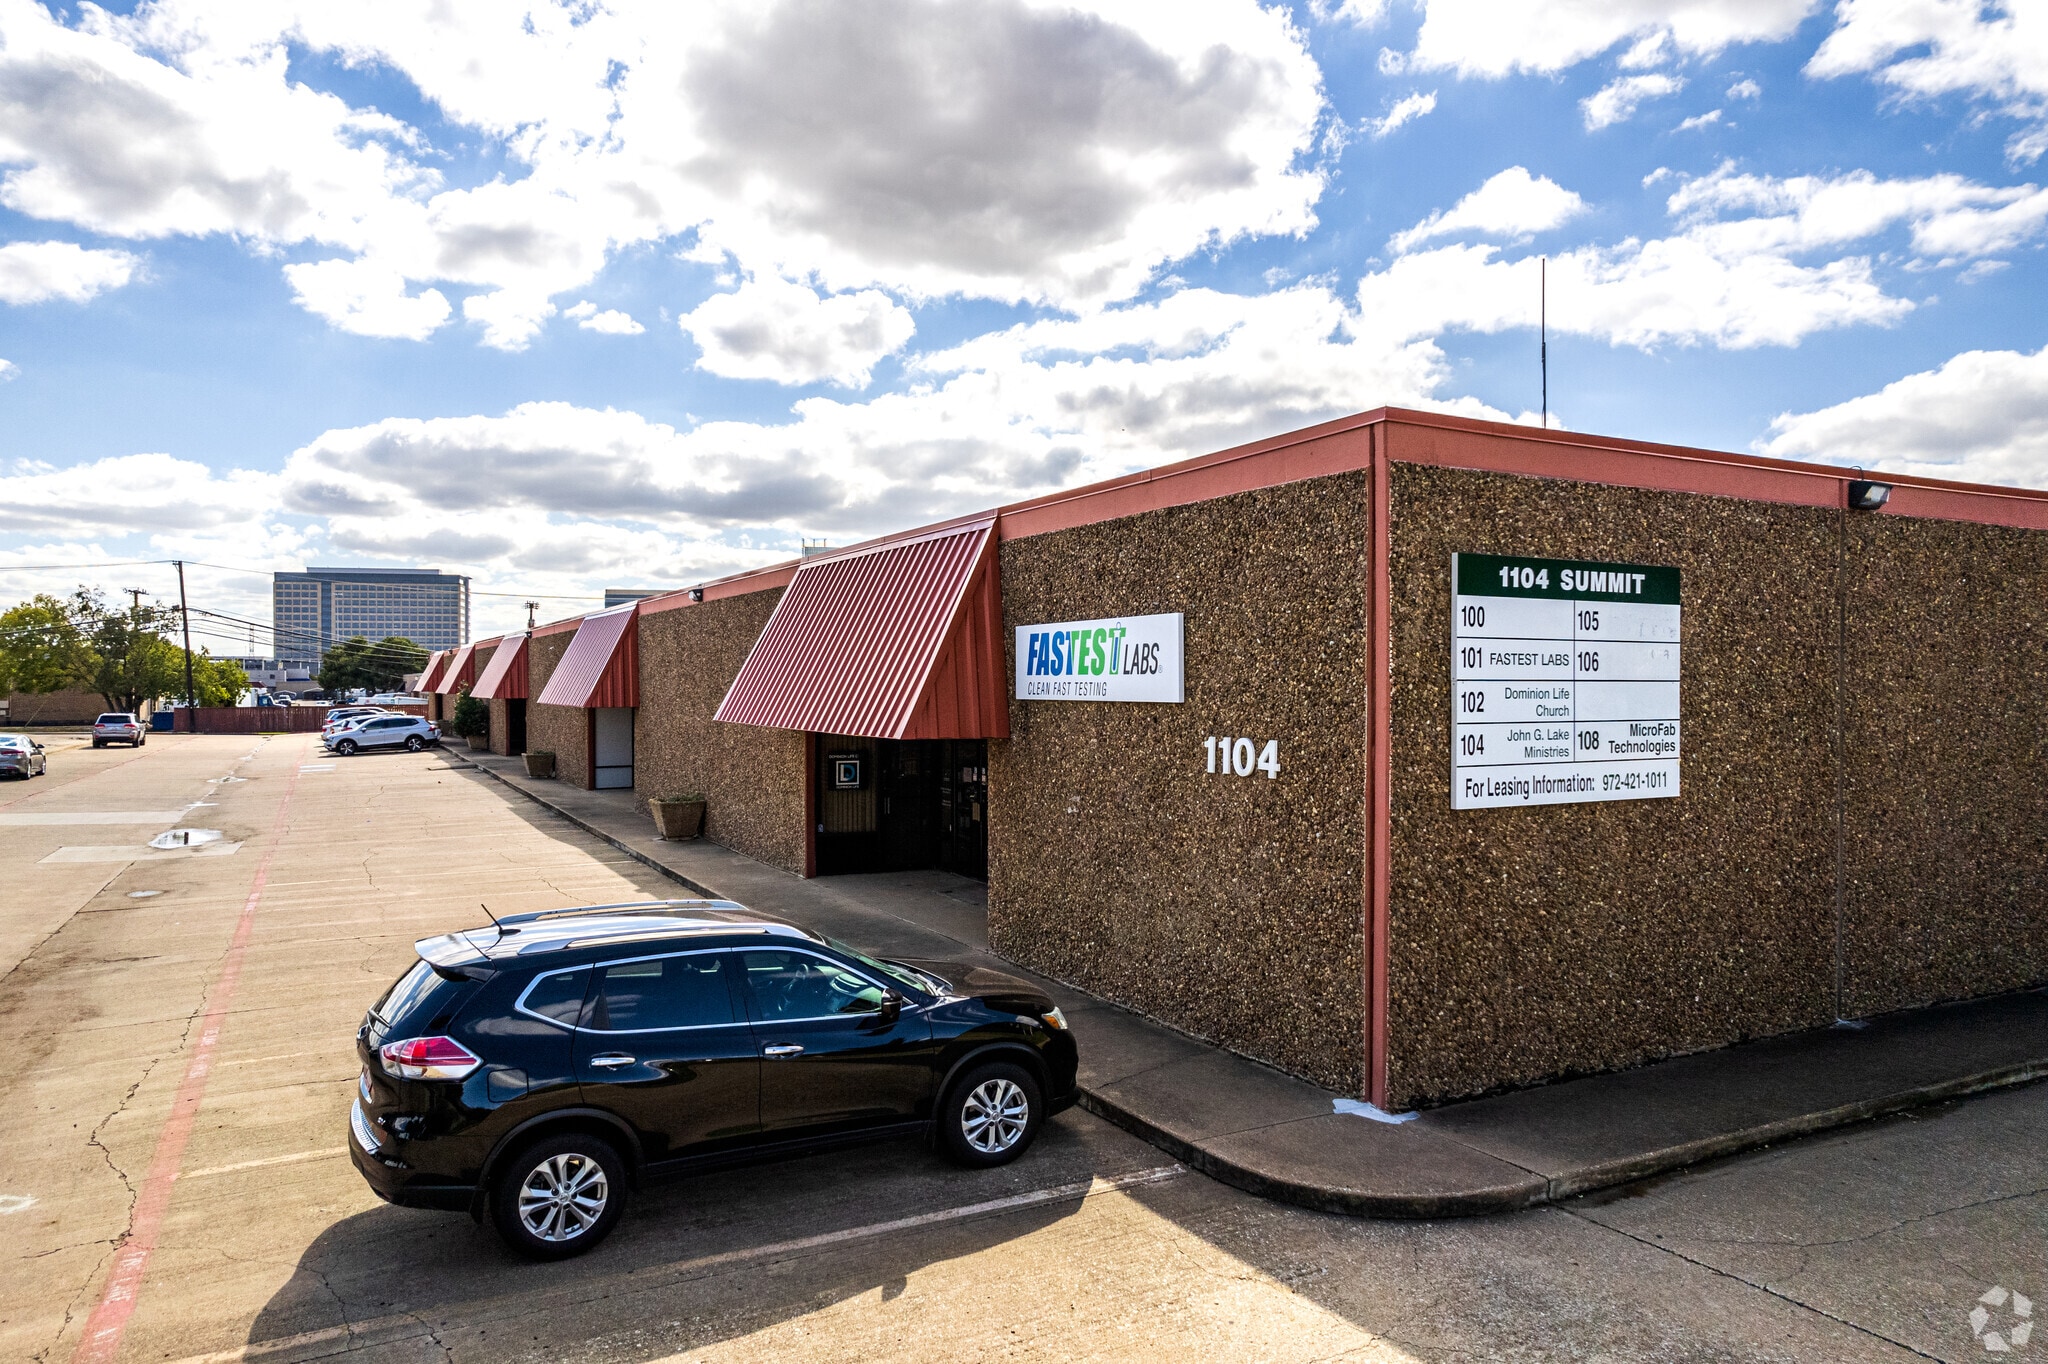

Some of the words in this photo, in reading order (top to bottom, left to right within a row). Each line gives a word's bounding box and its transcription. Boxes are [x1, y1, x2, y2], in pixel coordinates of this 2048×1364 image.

[1499, 566, 1549, 589] 1104
[1561, 570, 1645, 594] SUMMIT
[1461, 606, 1485, 627] 100
[1578, 611, 1599, 630] 105
[1027, 622, 1126, 676] FASTEST
[1461, 647, 1483, 668] 101
[1490, 653, 1538, 666] FASTEST
[1542, 654, 1569, 666] LABS
[1578, 652, 1599, 671] 106
[1028, 682, 1050, 695] CLEAN
[1053, 682, 1071, 695] FAST
[1074, 682, 1107, 696] TESTING
[1505, 687, 1550, 700] Dominion
[1553, 687, 1569, 699] Life
[1461, 692, 1484, 713] 102
[1536, 705, 1569, 717] Church
[1507, 729, 1531, 742] John
[1534, 730, 1544, 741] G.
[1548, 730, 1569, 740] Lake
[1630, 723, 1675, 736] MicroFab
[1461, 735, 1484, 755] 104
[1578, 731, 1599, 750] 108
[1609, 740, 1675, 755] Technologies
[1204, 736, 1280, 779] 1104
[1525, 747, 1569, 758] Ministries
[1466, 778, 1484, 797] For
[1487, 777, 1529, 799] Leasing
[1533, 773, 1595, 795] Information:
[1603, 771, 1667, 791] 972-421-1011
